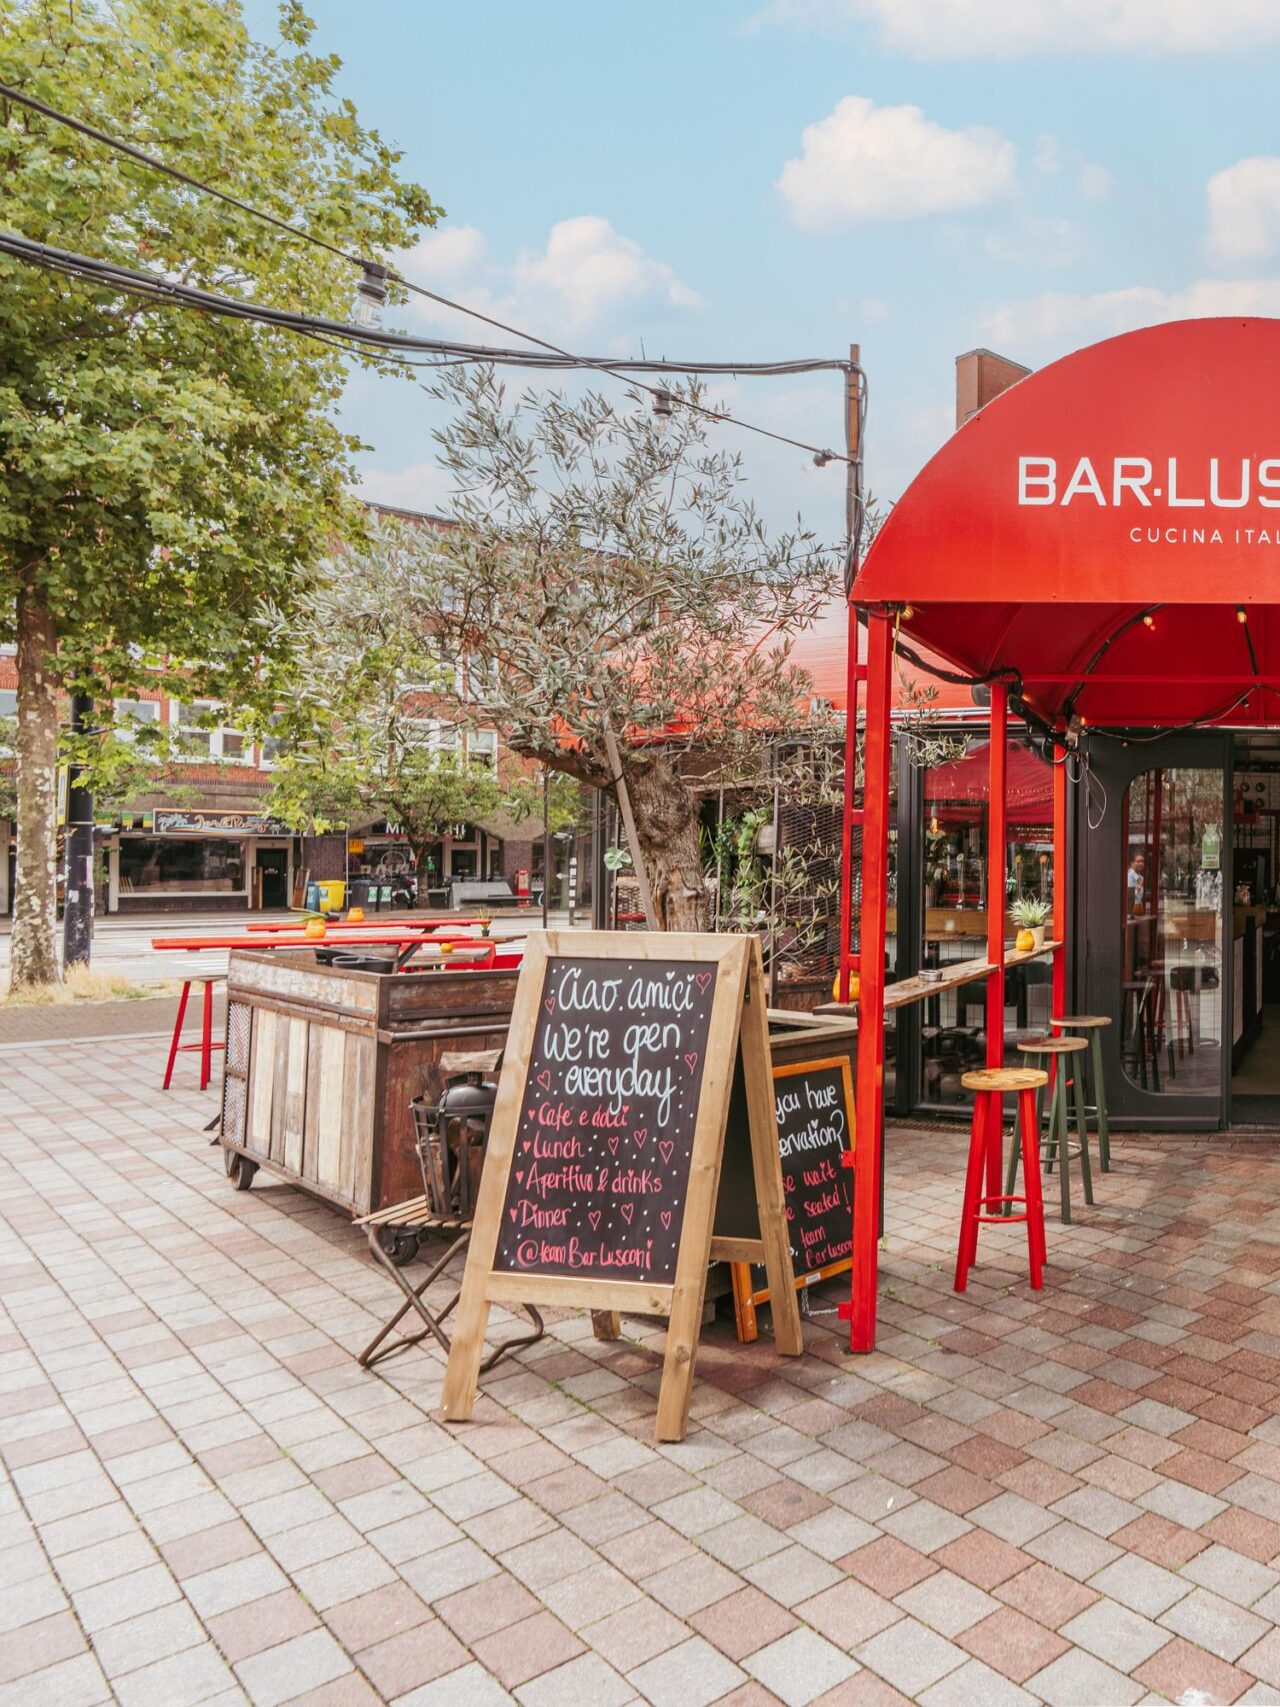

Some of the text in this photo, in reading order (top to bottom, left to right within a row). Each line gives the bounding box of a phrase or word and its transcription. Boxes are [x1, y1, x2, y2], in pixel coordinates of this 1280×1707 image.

[1130, 527, 1224, 544] CUCINA
[627, 971, 695, 1011] amici
[543, 1022, 681, 1067] We're open
[564, 1064, 677, 1127] everyday
[775, 1080, 838, 1124] you have
[579, 1110, 589, 1126] e
[533, 1130, 586, 1159] Lunch
[611, 1168, 663, 1194] drinks
[803, 1159, 837, 1187] wait
[517, 1199, 572, 1229] Dinner
[800, 1226, 826, 1248] team
